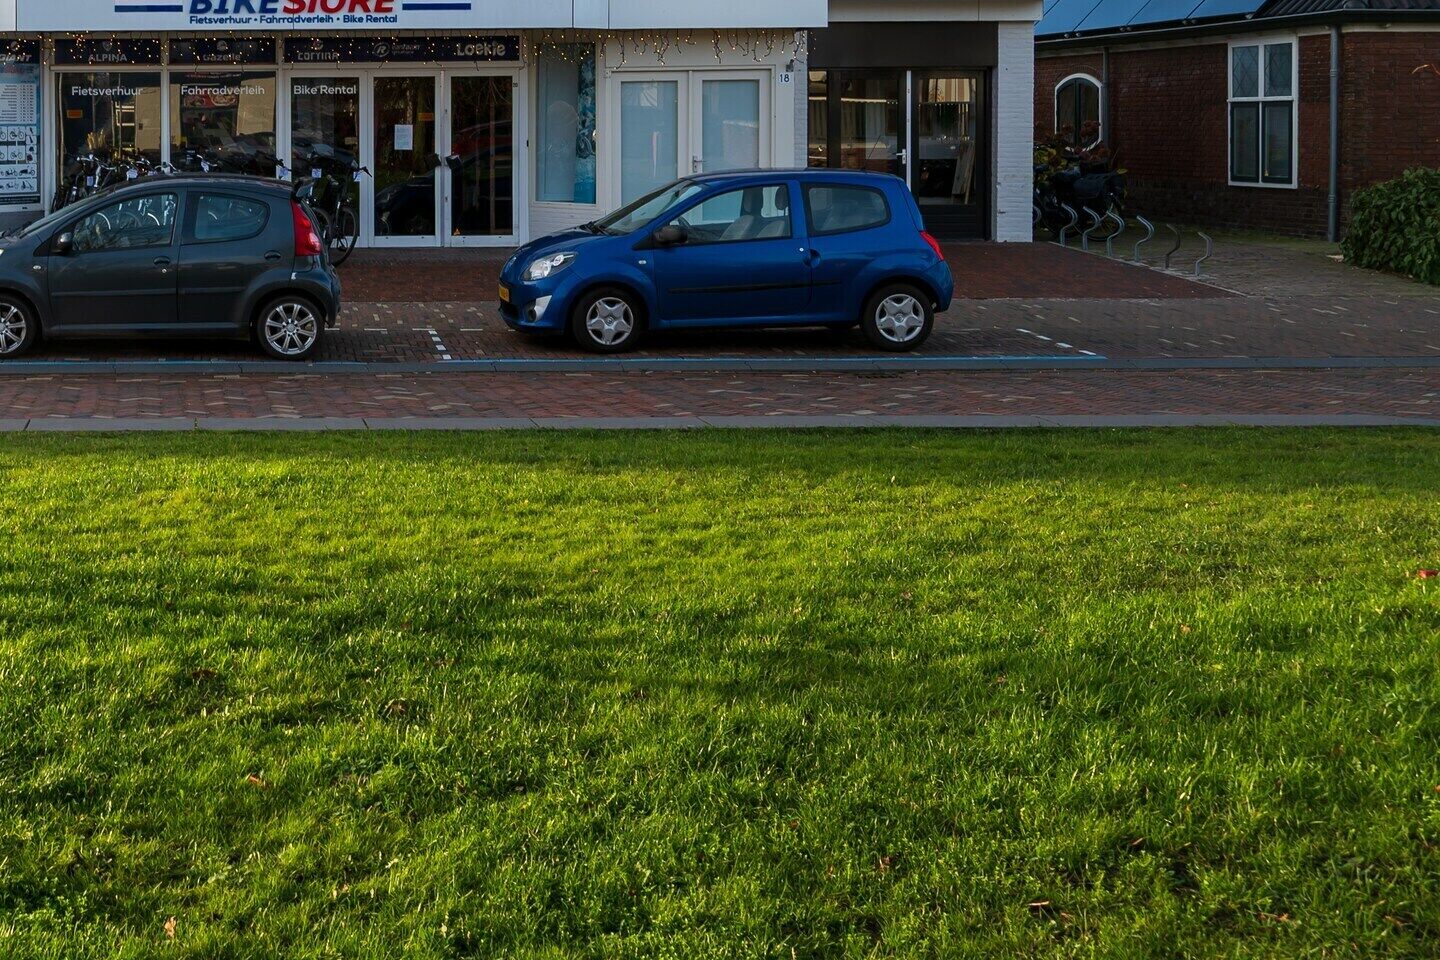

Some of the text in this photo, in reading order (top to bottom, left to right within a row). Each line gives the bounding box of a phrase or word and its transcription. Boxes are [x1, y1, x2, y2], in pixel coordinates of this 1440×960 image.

[189, 14, 398, 24] Fietsverhuur Fahrradverleih Bike Rental
[88, 53, 128, 62] ALPINA
[203, 53, 241, 61] Gazelle
[779, 73, 790, 83] 18
[71, 86, 142, 96] Fietsverhuur
[180, 86, 265, 96] Fahrradverleih
[293, 85, 357, 95] Bike Rental
